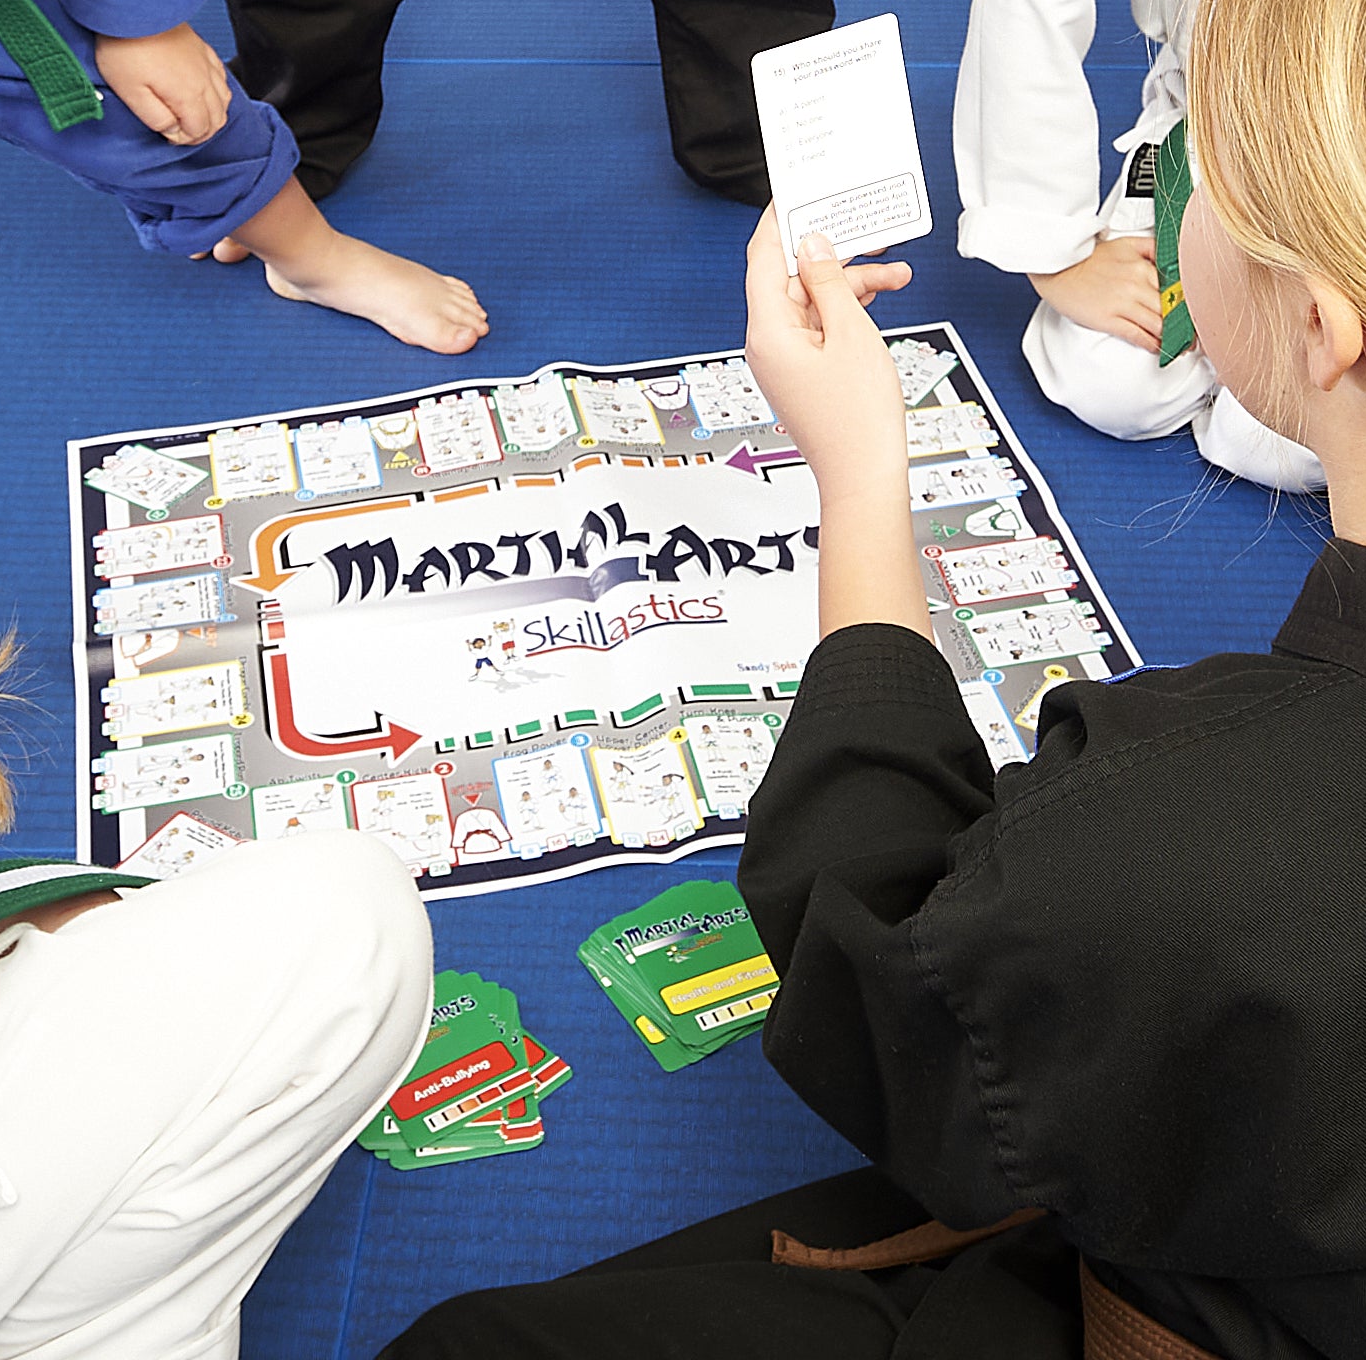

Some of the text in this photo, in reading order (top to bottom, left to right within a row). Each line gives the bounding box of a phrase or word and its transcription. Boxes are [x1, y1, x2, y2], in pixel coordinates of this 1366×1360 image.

[793, 61, 810, 71] Who
[813, 51, 840, 65] should
[843, 47, 857, 57] you
[860, 40, 882, 50] share
[794, 71, 812, 84] your
[814, 58, 853, 77] password
[323, 502, 649, 606] MARTIAL
[524, 591, 724, 652] Skillastics
[737, 662, 770, 673] Sandy
[728, 715, 762, 723] Punch
[503, 746, 529, 759] Frog
[531, 737, 567, 753] Power
[362, 771, 400, 782] Center
[623, 907, 750, 946] MARTIAL ARTS
[670, 984, 711, 1005] Health
[713, 976, 736, 990] and
[414, 1059, 491, 1102] Anti-Bullying
